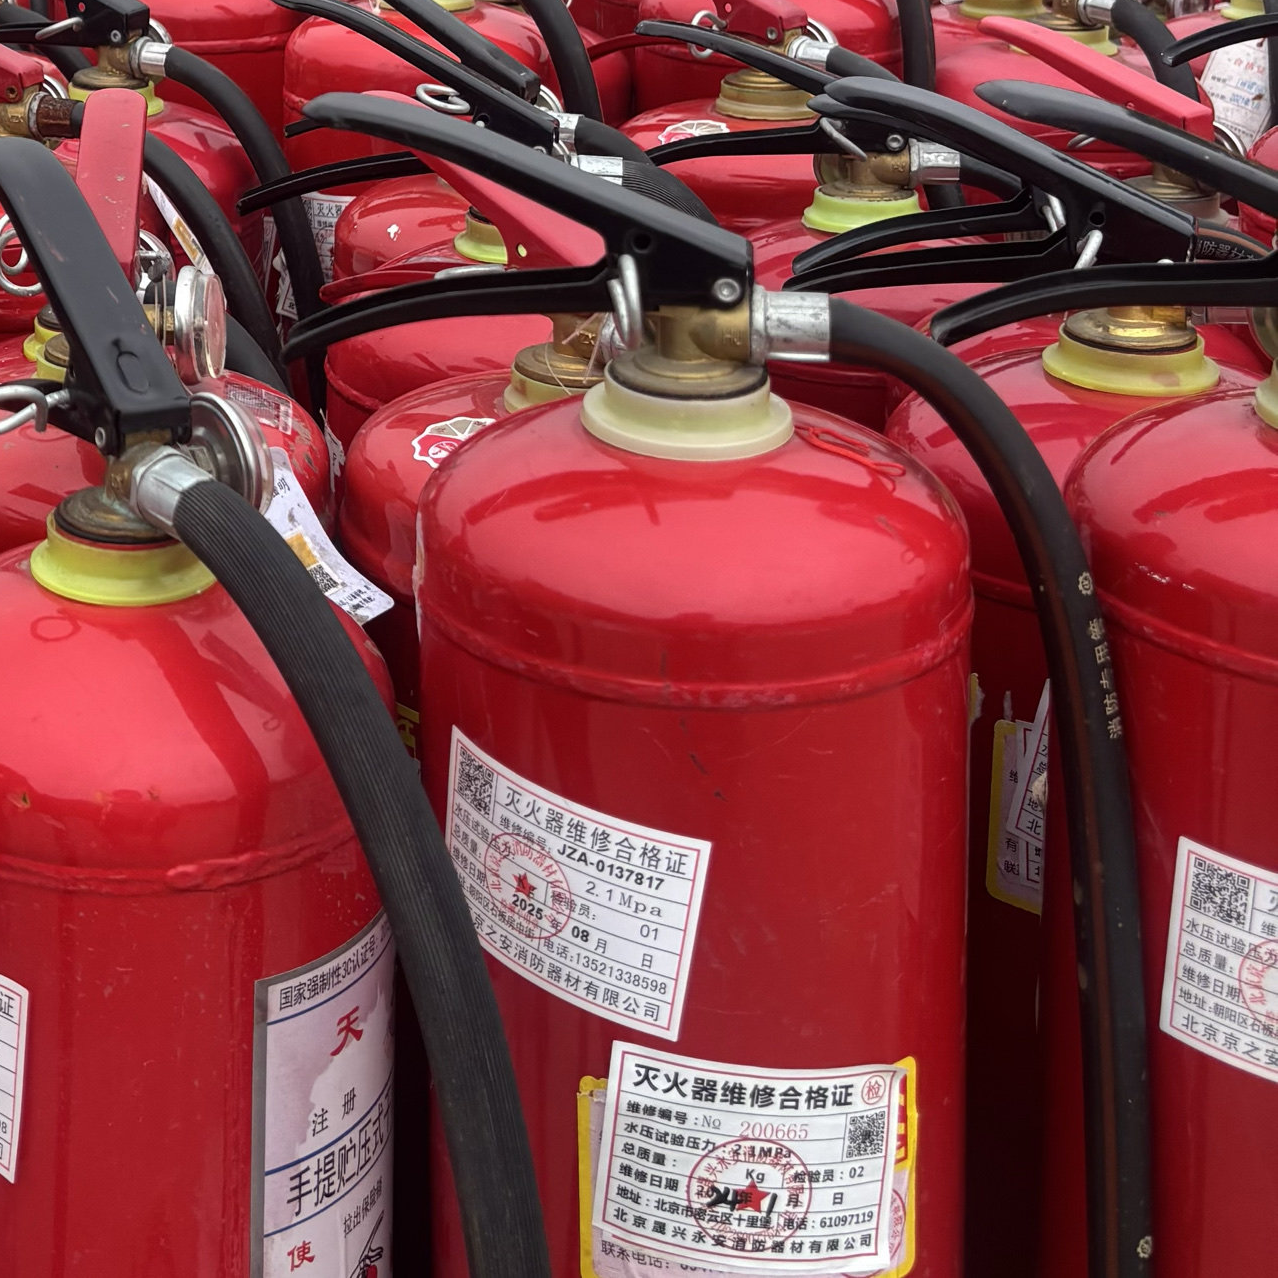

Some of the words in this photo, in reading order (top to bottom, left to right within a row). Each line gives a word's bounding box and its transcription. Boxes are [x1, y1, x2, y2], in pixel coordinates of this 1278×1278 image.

[506, 785, 689, 876] 灭火器维修合格证
[556, 842, 665, 891] JZA-0137817
[511, 893, 544, 922] 2025
[571, 925, 590, 944] 08
[594, 937, 608, 955] 月
[641, 952, 654, 970] 日
[639, 924, 659, 941] 01
[330, 1005, 364, 1057] 天
[632, 1062, 854, 1110] 灭火器维修合格证
[738, 1120, 809, 1140] 200665
[618, 1162, 679, 1192] 维修日期
[832, 1192, 844, 1206] 日
[745, 1168, 765, 1184] Kg
[287, 1240, 316, 1273] 使
